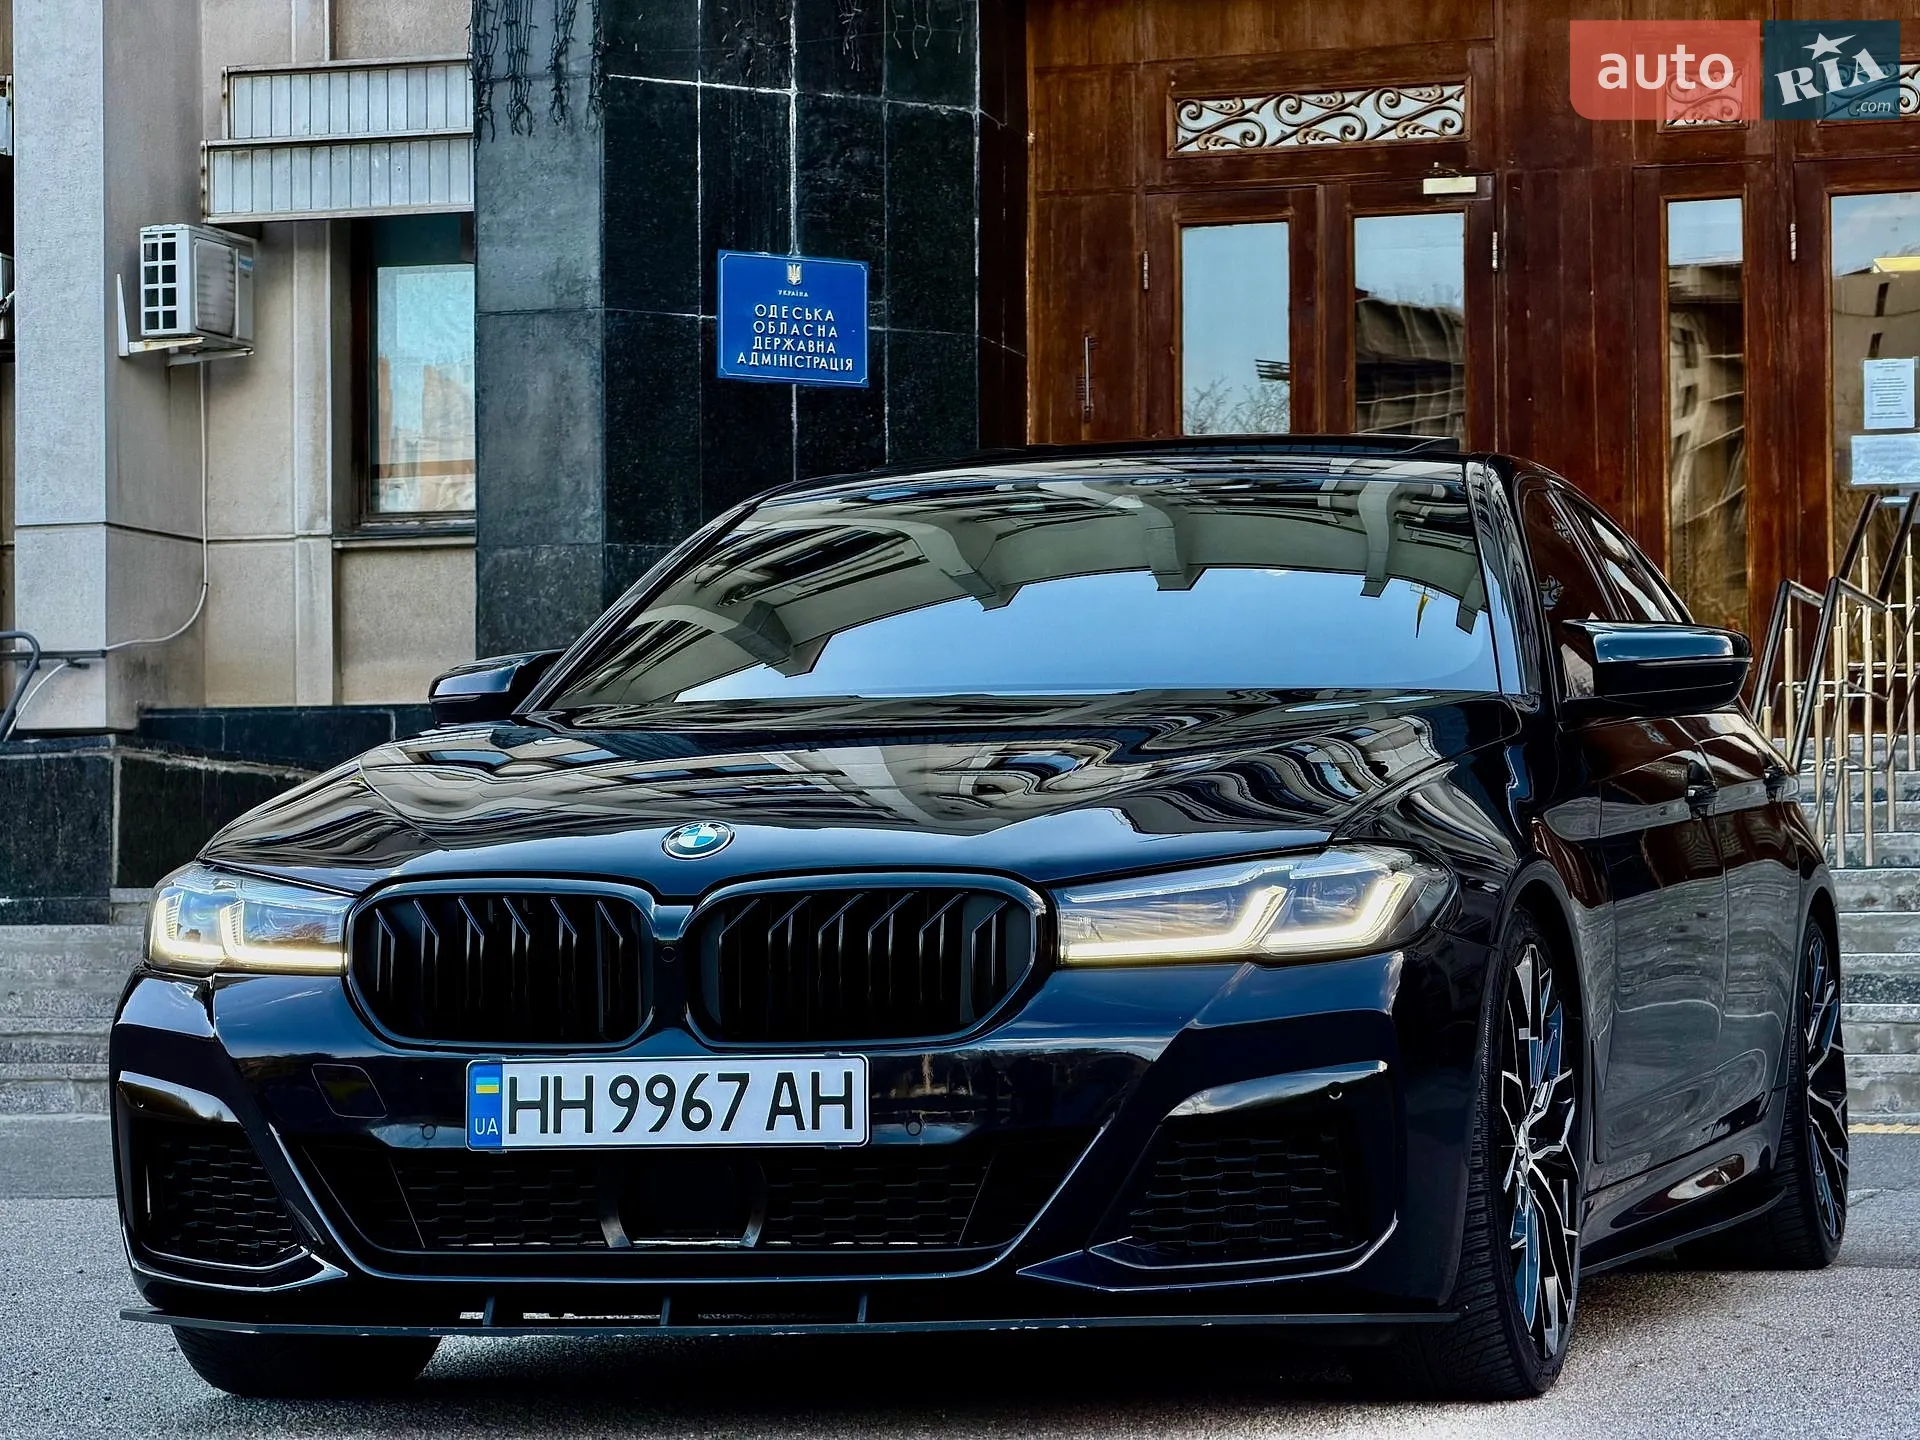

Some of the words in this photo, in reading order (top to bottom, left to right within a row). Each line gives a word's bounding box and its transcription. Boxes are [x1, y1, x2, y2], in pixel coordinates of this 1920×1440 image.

[754, 304, 835, 322] ОДЕСЬКА
[753, 320, 838, 338] ОБЛАСНА
[753, 336, 836, 354] ДЕРЖАВНА
[737, 352, 853, 372] АДМІНІСТРАЦІЯ
[508, 1075, 594, 1135] HH
[608, 1072, 750, 1133] 9967
[765, 1071, 853, 1132] AH
[474, 1117, 499, 1136] UA
